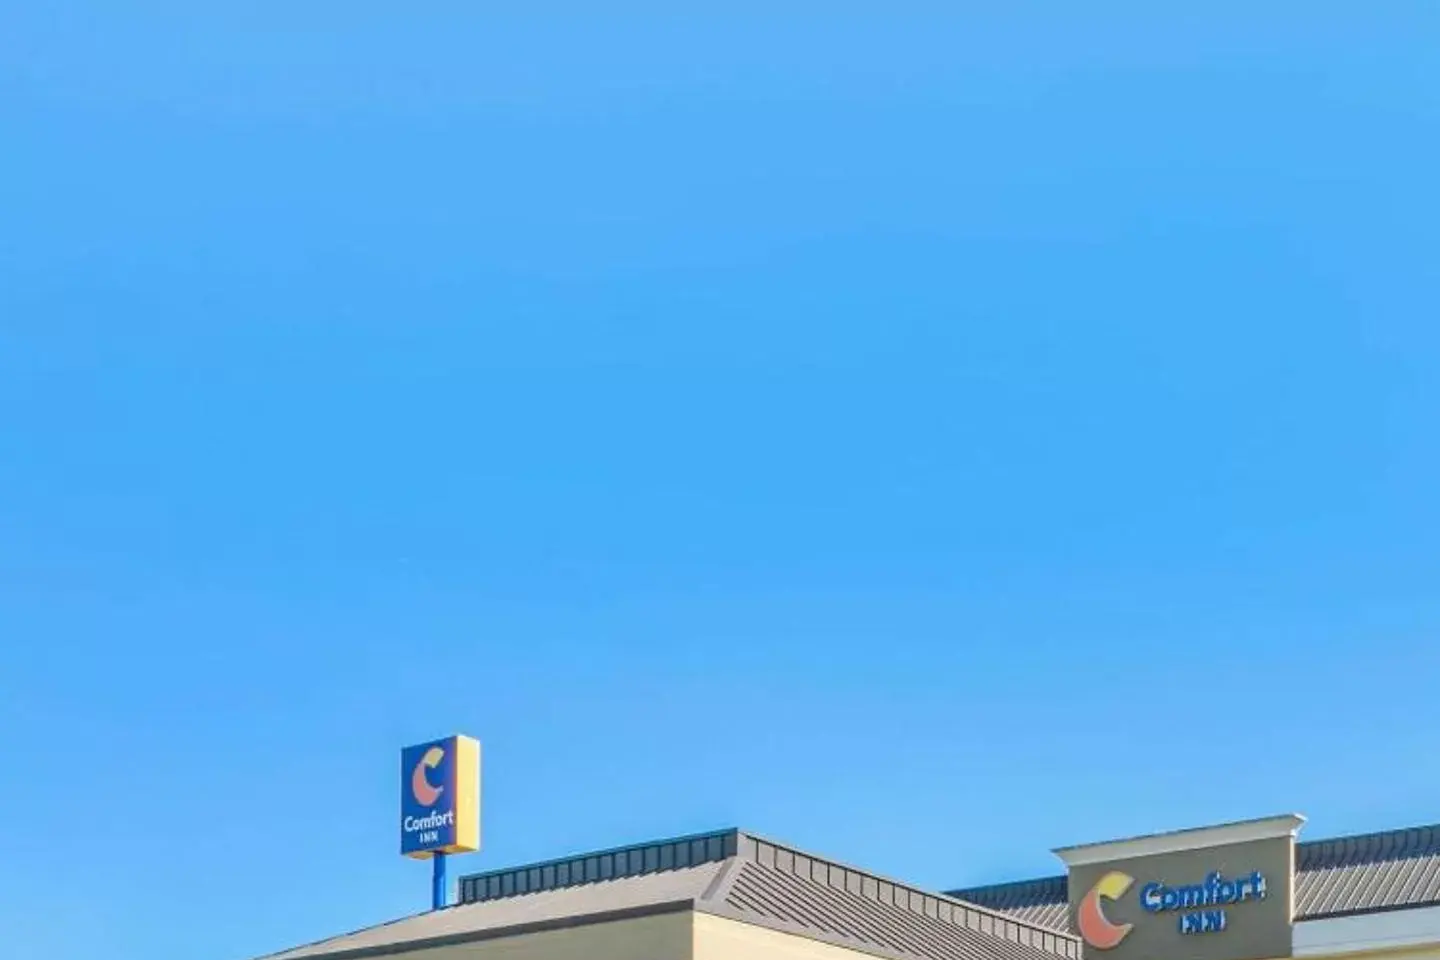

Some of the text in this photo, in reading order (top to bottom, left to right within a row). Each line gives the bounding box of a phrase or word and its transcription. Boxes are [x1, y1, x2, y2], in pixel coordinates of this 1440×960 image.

[404, 810, 454, 832] Comfort
[419, 831, 439, 843] INN
[1140, 870, 1266, 911] Comfort
[1179, 910, 1226, 935] INN
